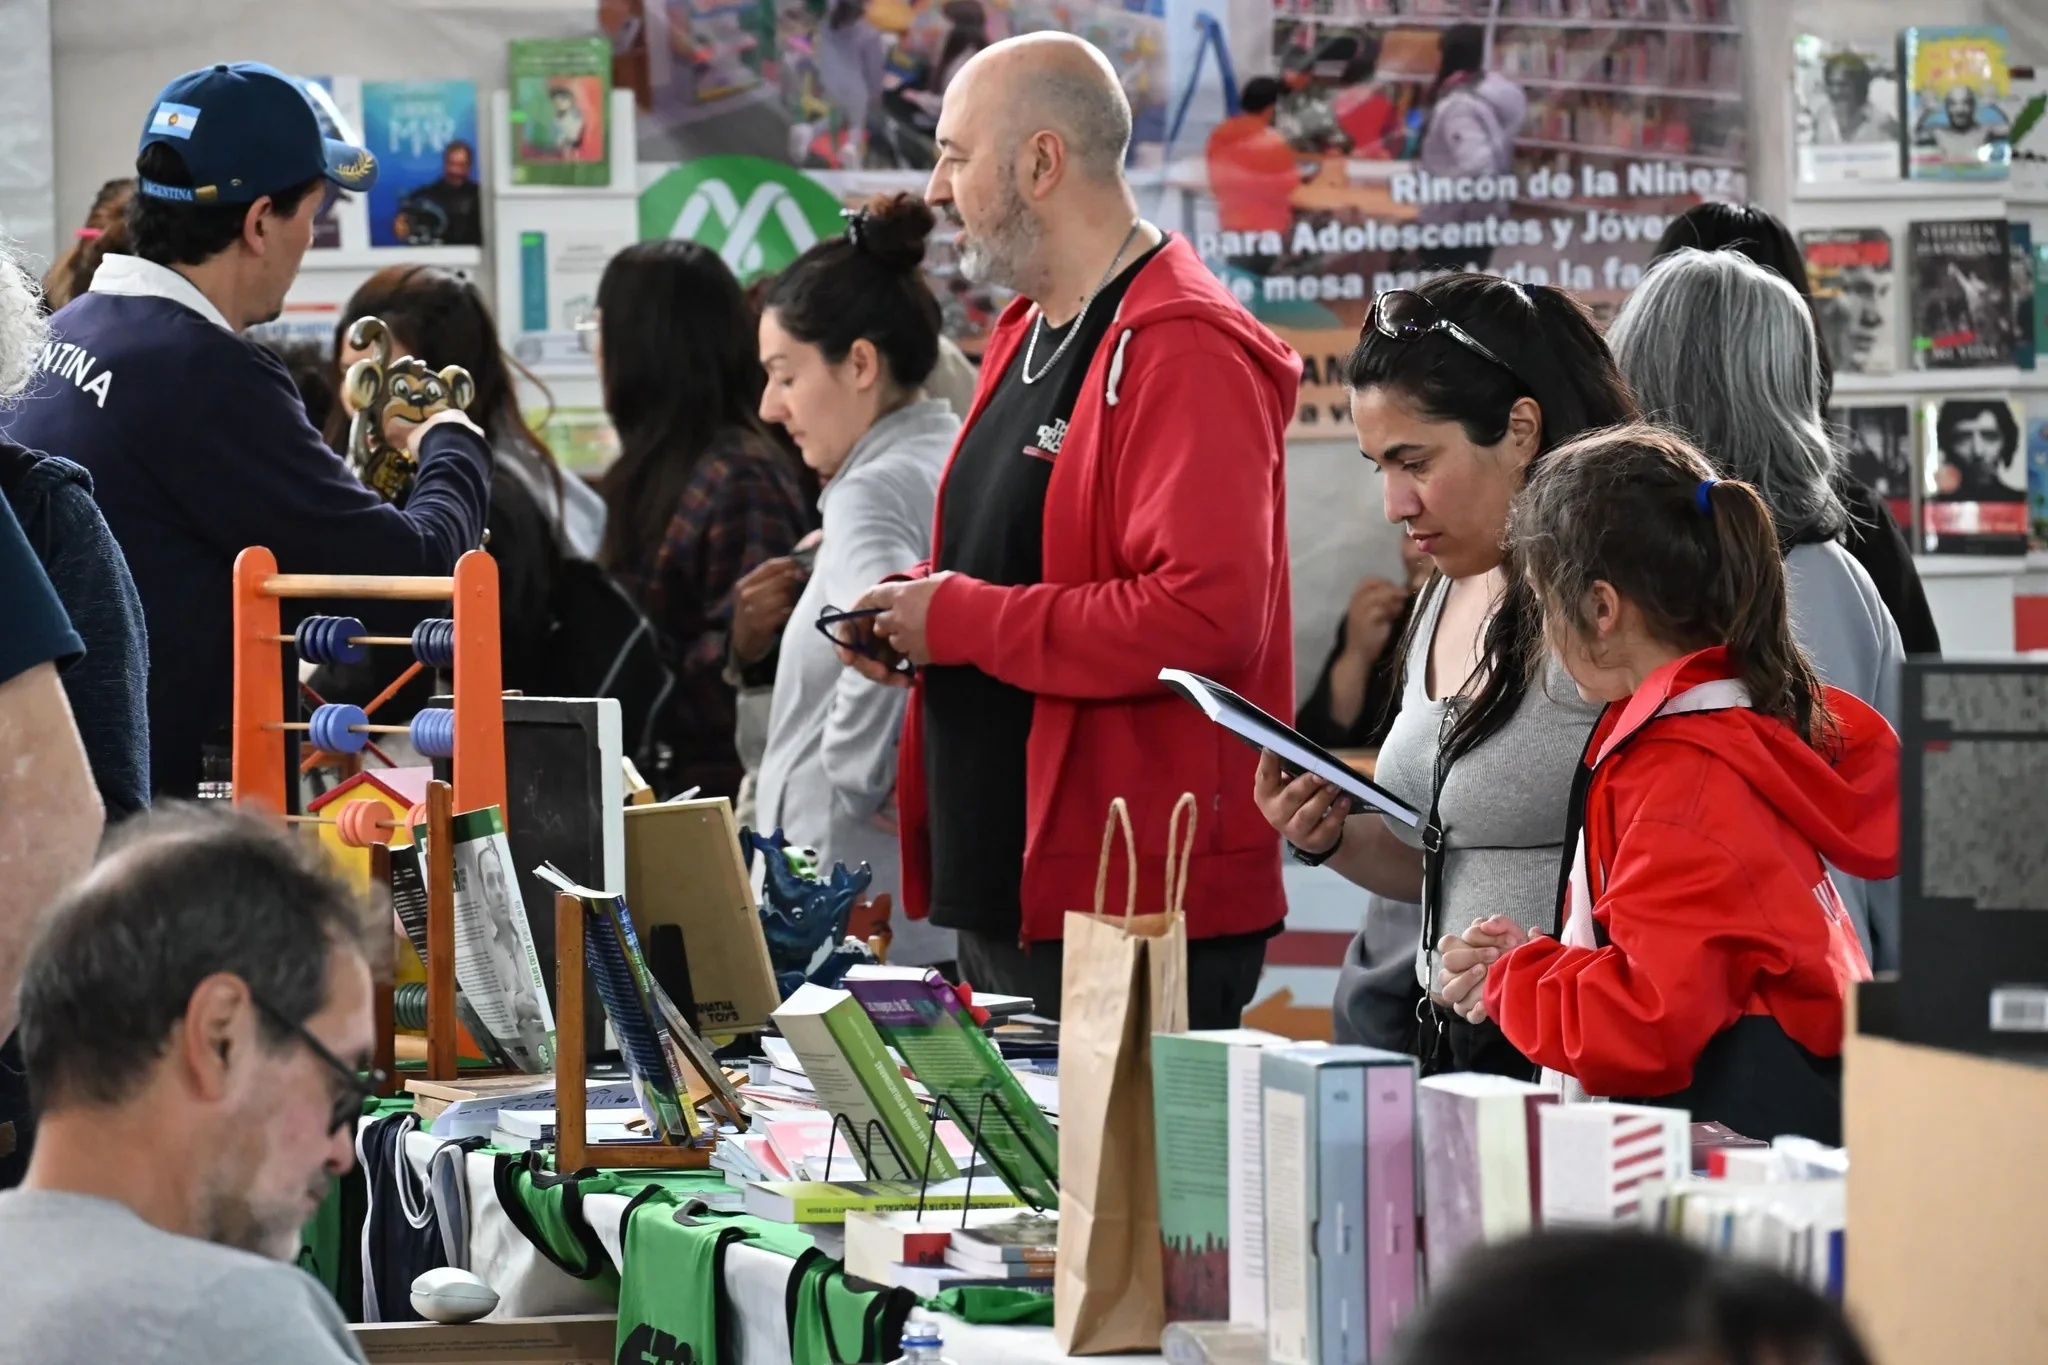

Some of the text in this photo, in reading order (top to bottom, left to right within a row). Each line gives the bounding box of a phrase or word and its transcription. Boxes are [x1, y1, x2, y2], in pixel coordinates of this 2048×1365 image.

[142, 177, 194, 201] ARGENTINA
[1528, 166, 1574, 198] de
[1582, 164, 1618, 196] la
[1627, 162, 1731, 196] Niñez
[1197, 209, 1670, 262] para Adolescentes y Jóve
[1262, 273, 1365, 299] mesa
[1557, 258, 1594, 289] la
[35, 341, 113, 409] NTINA
[531, 966, 543, 988] CARLOS
[874, 1060, 907, 1111] REVOLUCIONARIAS
